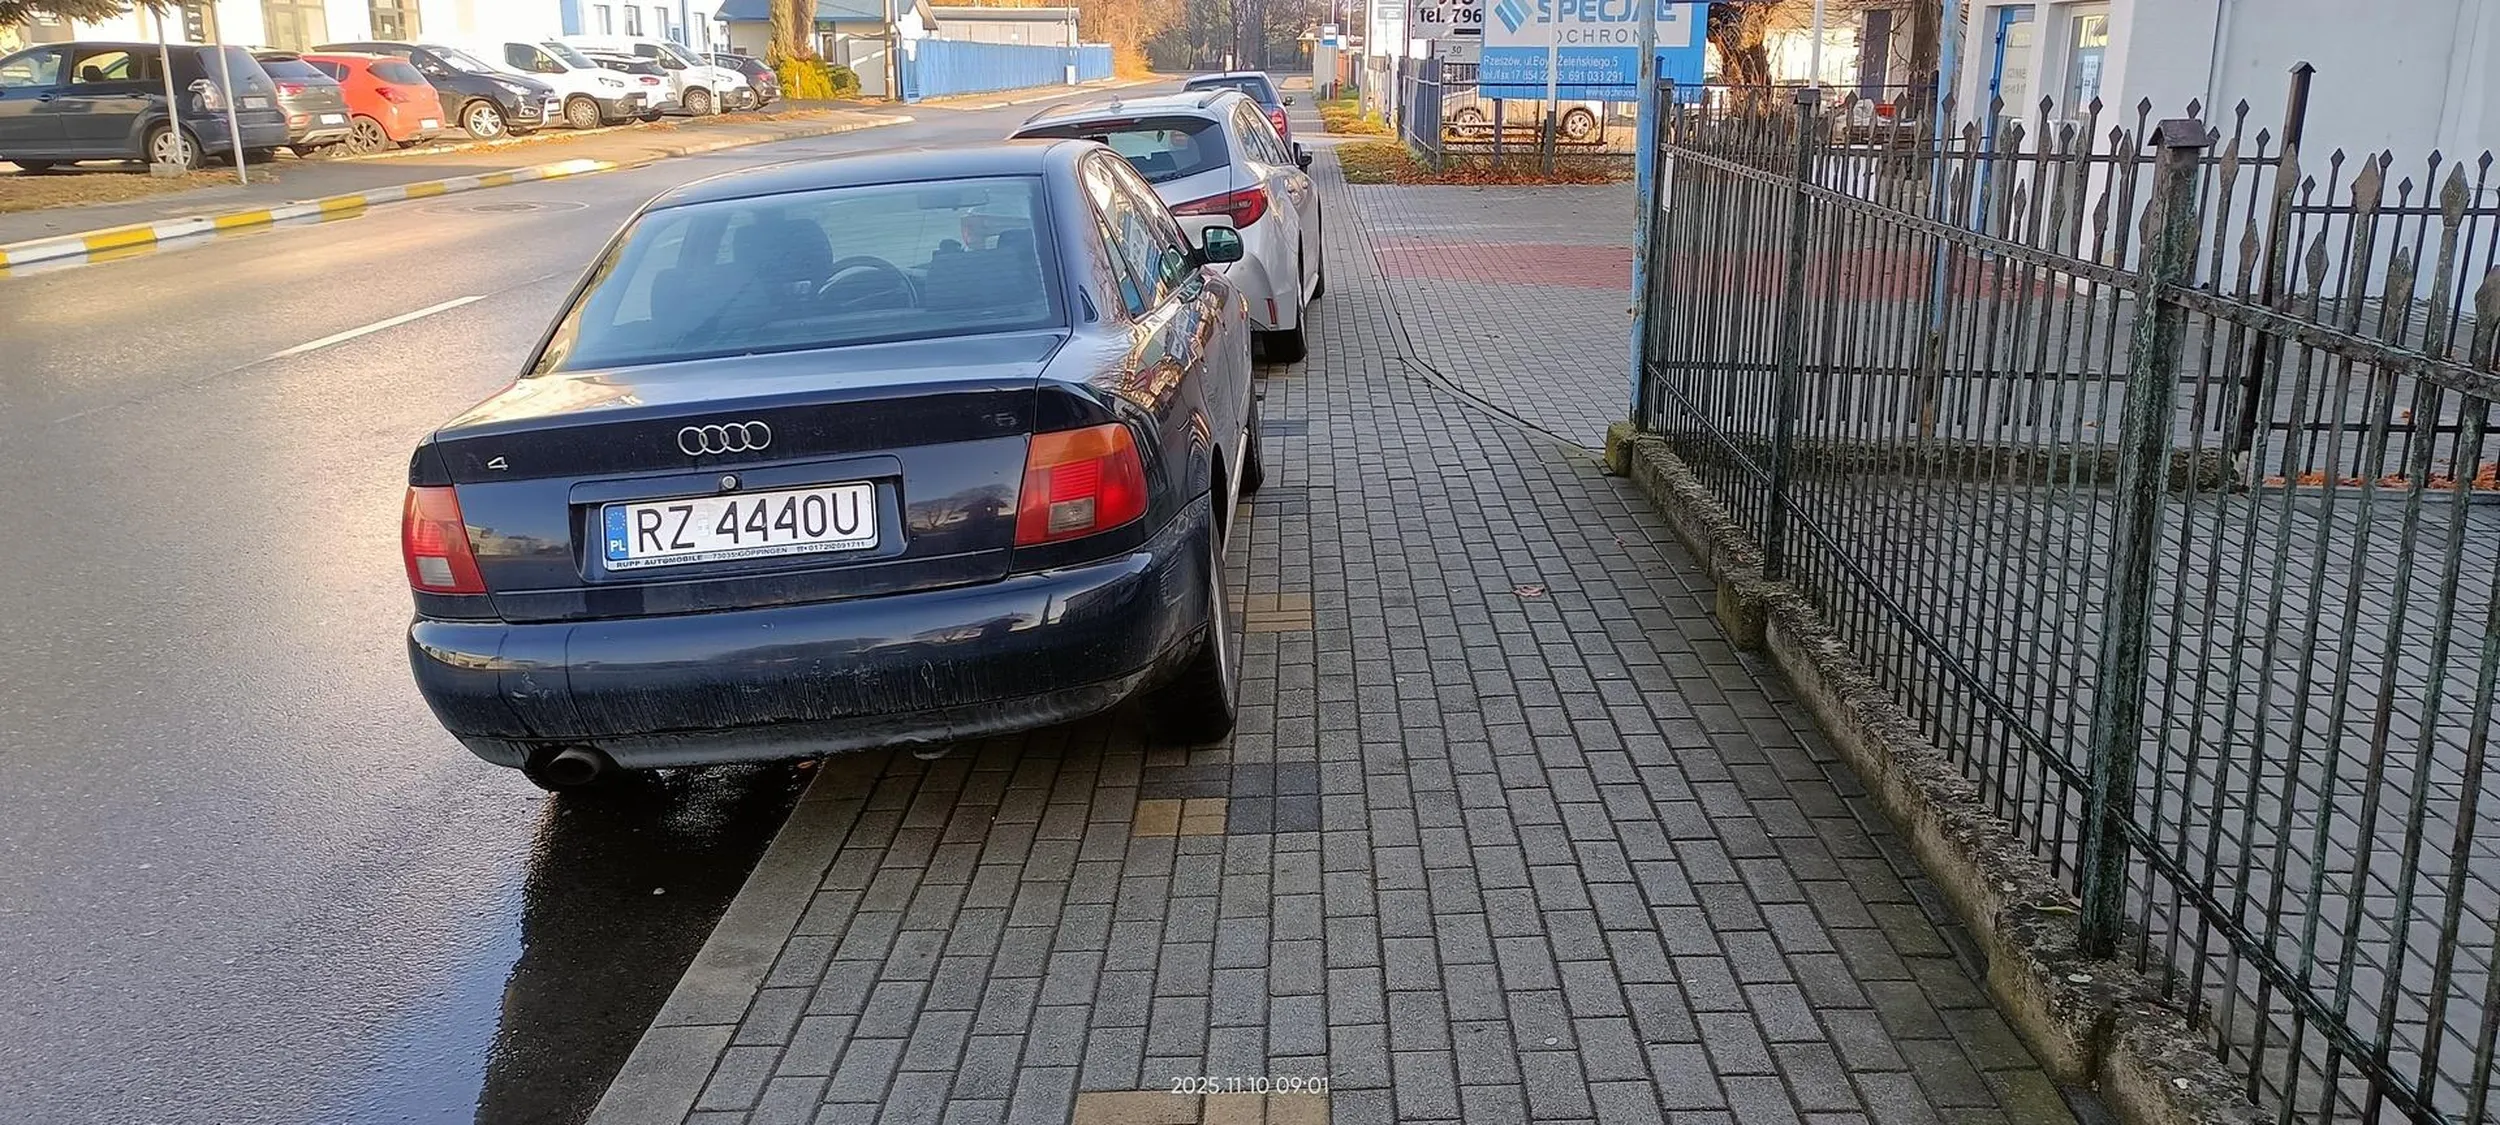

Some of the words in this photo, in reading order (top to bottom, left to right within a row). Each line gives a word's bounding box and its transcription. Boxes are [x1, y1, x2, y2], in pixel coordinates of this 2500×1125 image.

[1420, 8, 1445, 23] tel.
[1452, 8, 1482, 23] 796
[1537, 0, 1677, 23] SPECJŁ
[637, 504, 695, 553] RZ
[716, 491, 859, 545] 4440U
[610, 540, 626, 552] PL
